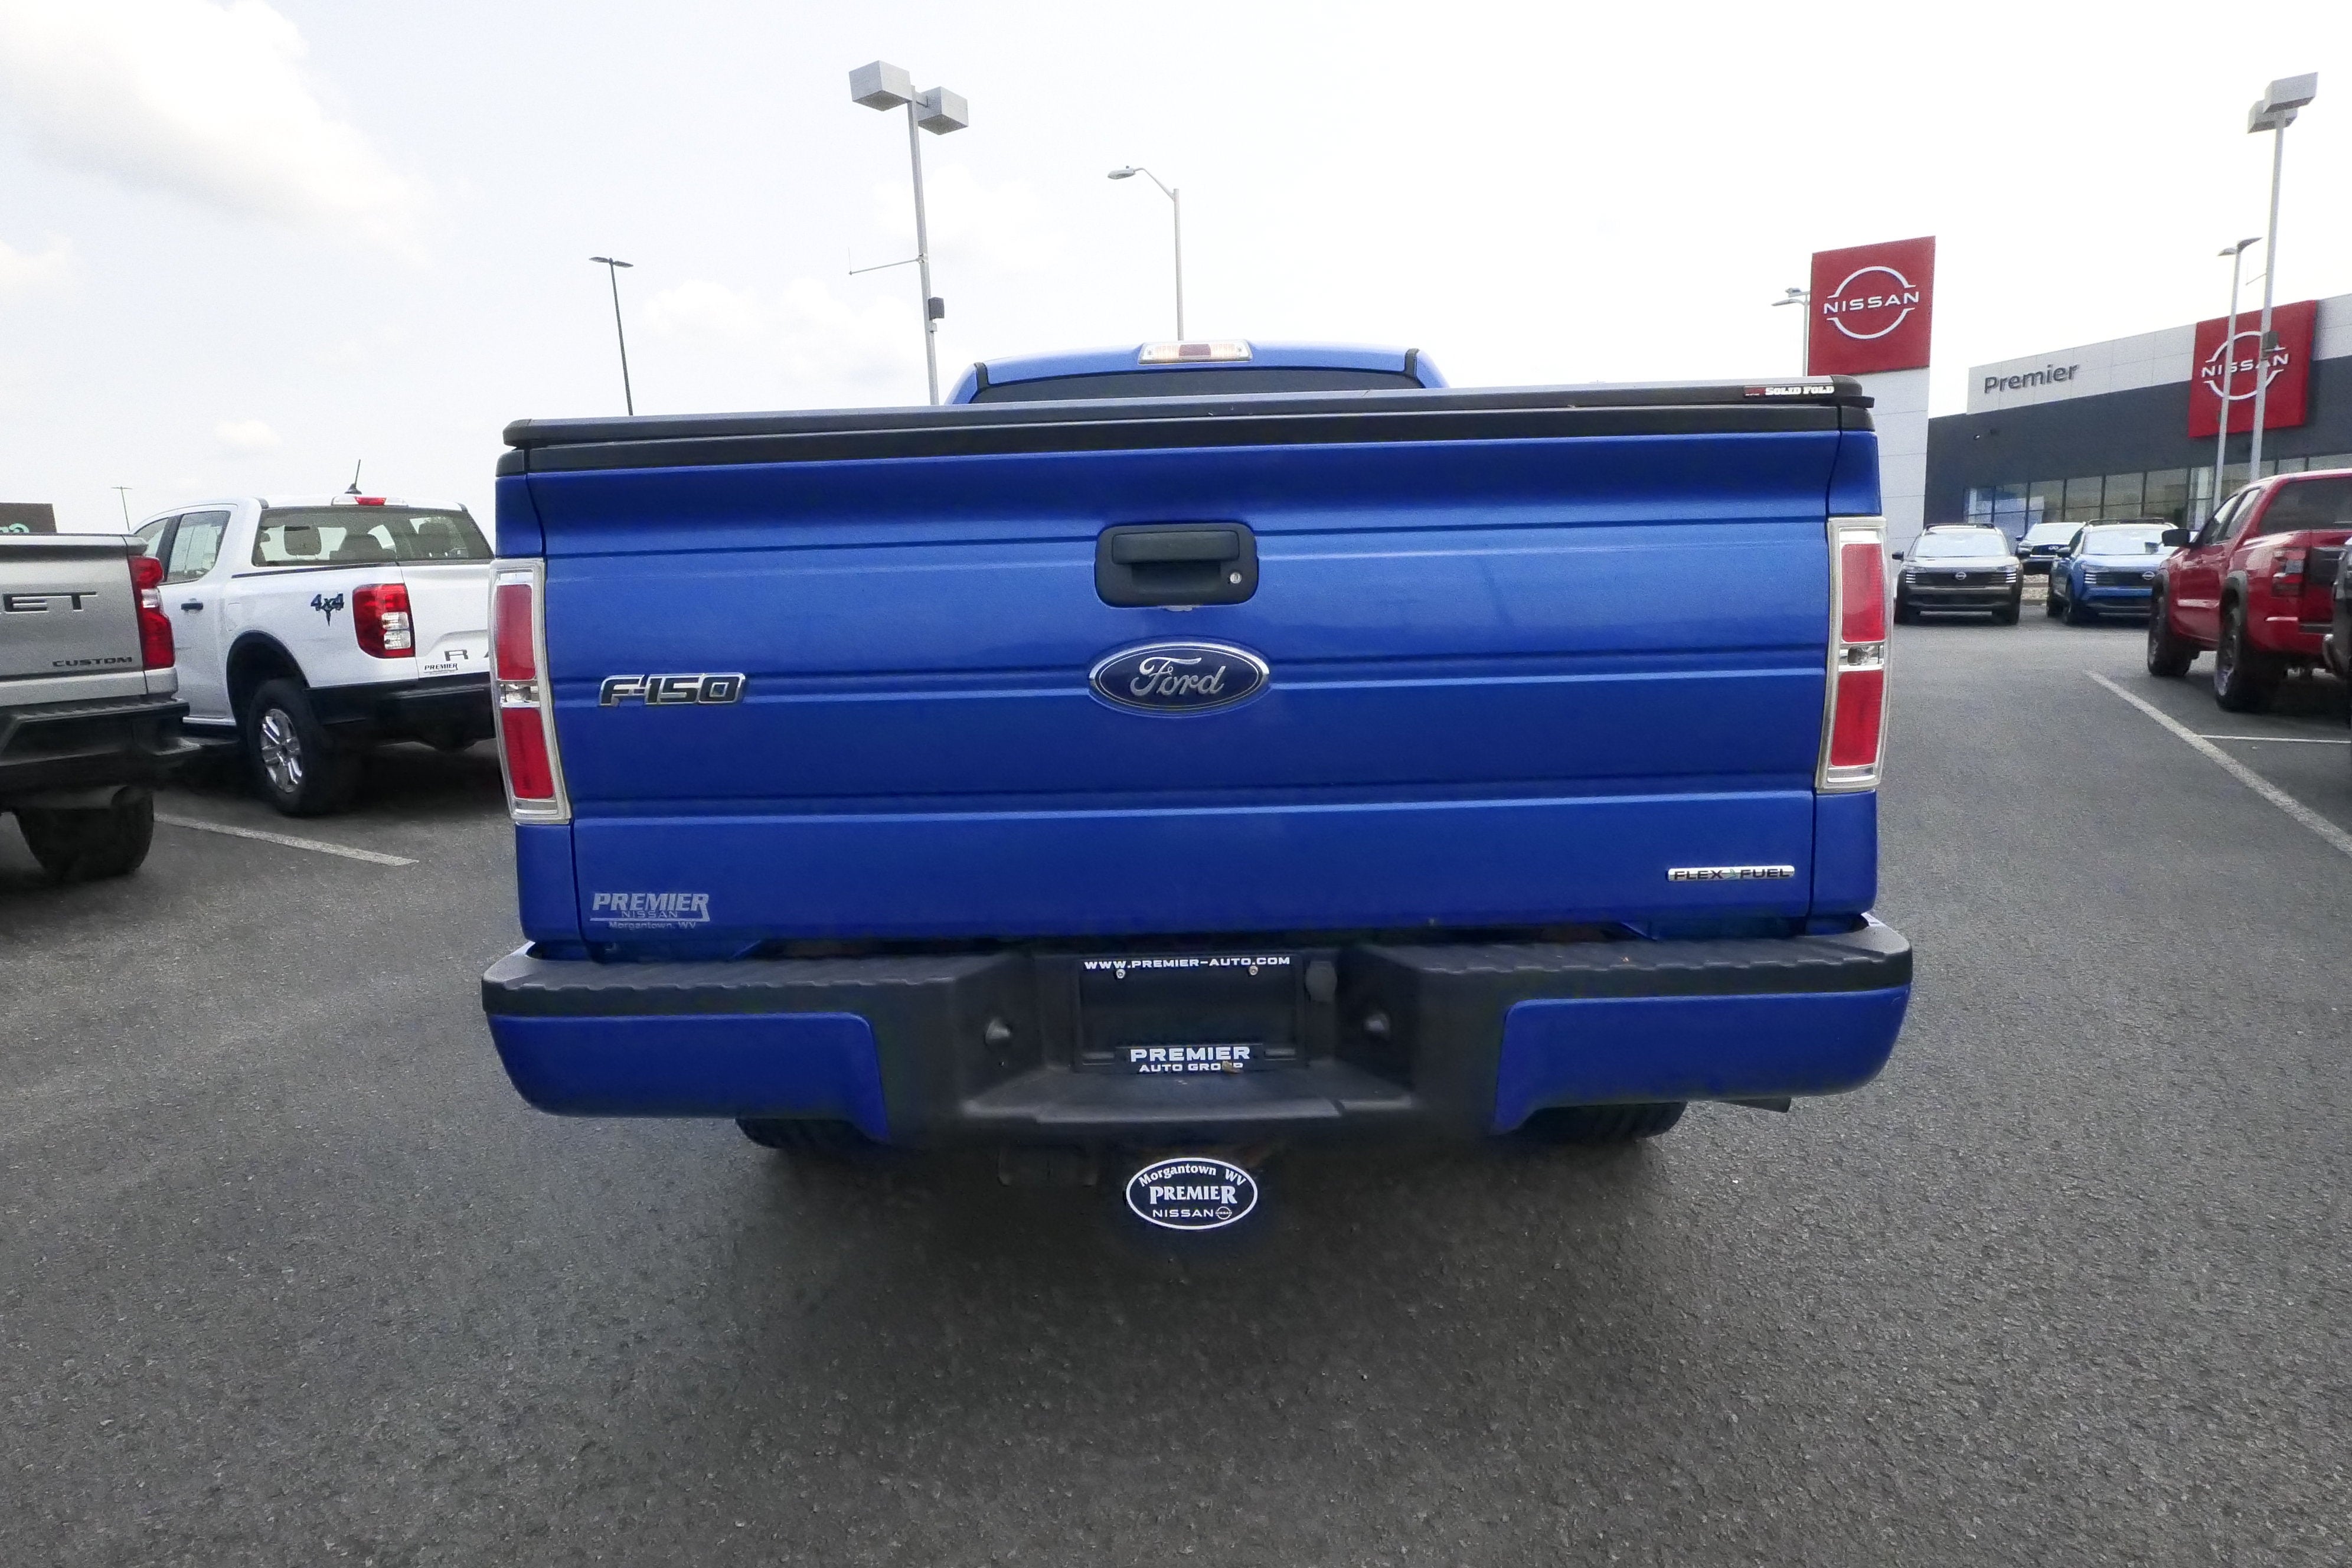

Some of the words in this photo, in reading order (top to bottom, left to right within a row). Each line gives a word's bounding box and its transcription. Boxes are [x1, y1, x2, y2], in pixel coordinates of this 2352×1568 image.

[1824, 292, 1919, 314] NISSAN
[1984, 364, 2079, 394] Premier
[1765, 387, 1801, 396] SOLID
[1803, 386, 1834, 394] FOLD
[311, 593, 345, 611] 4x4
[53, 656, 132, 667] CUSTOM
[424, 662, 458, 671] PREMIER
[1130, 656, 1226, 695] Ford
[1674, 870, 1724, 880] FLEX
[1740, 868, 1790, 879] FUEL
[592, 893, 710, 921] PREMIER
[1084, 957, 1290, 969] WWW.PREMIER-AUTO.COM
[1131, 1046, 1250, 1062] PREMIER
[1139, 1064, 1183, 1072] AUTO
[1188, 1063, 1243, 1071] GROP
[1138, 1164, 1216, 1187] Morgantown
[1225, 1168, 1247, 1186] WV
[1149, 1185, 1237, 1204] PREMIER
[1152, 1209, 1213, 1217] NISSAN
